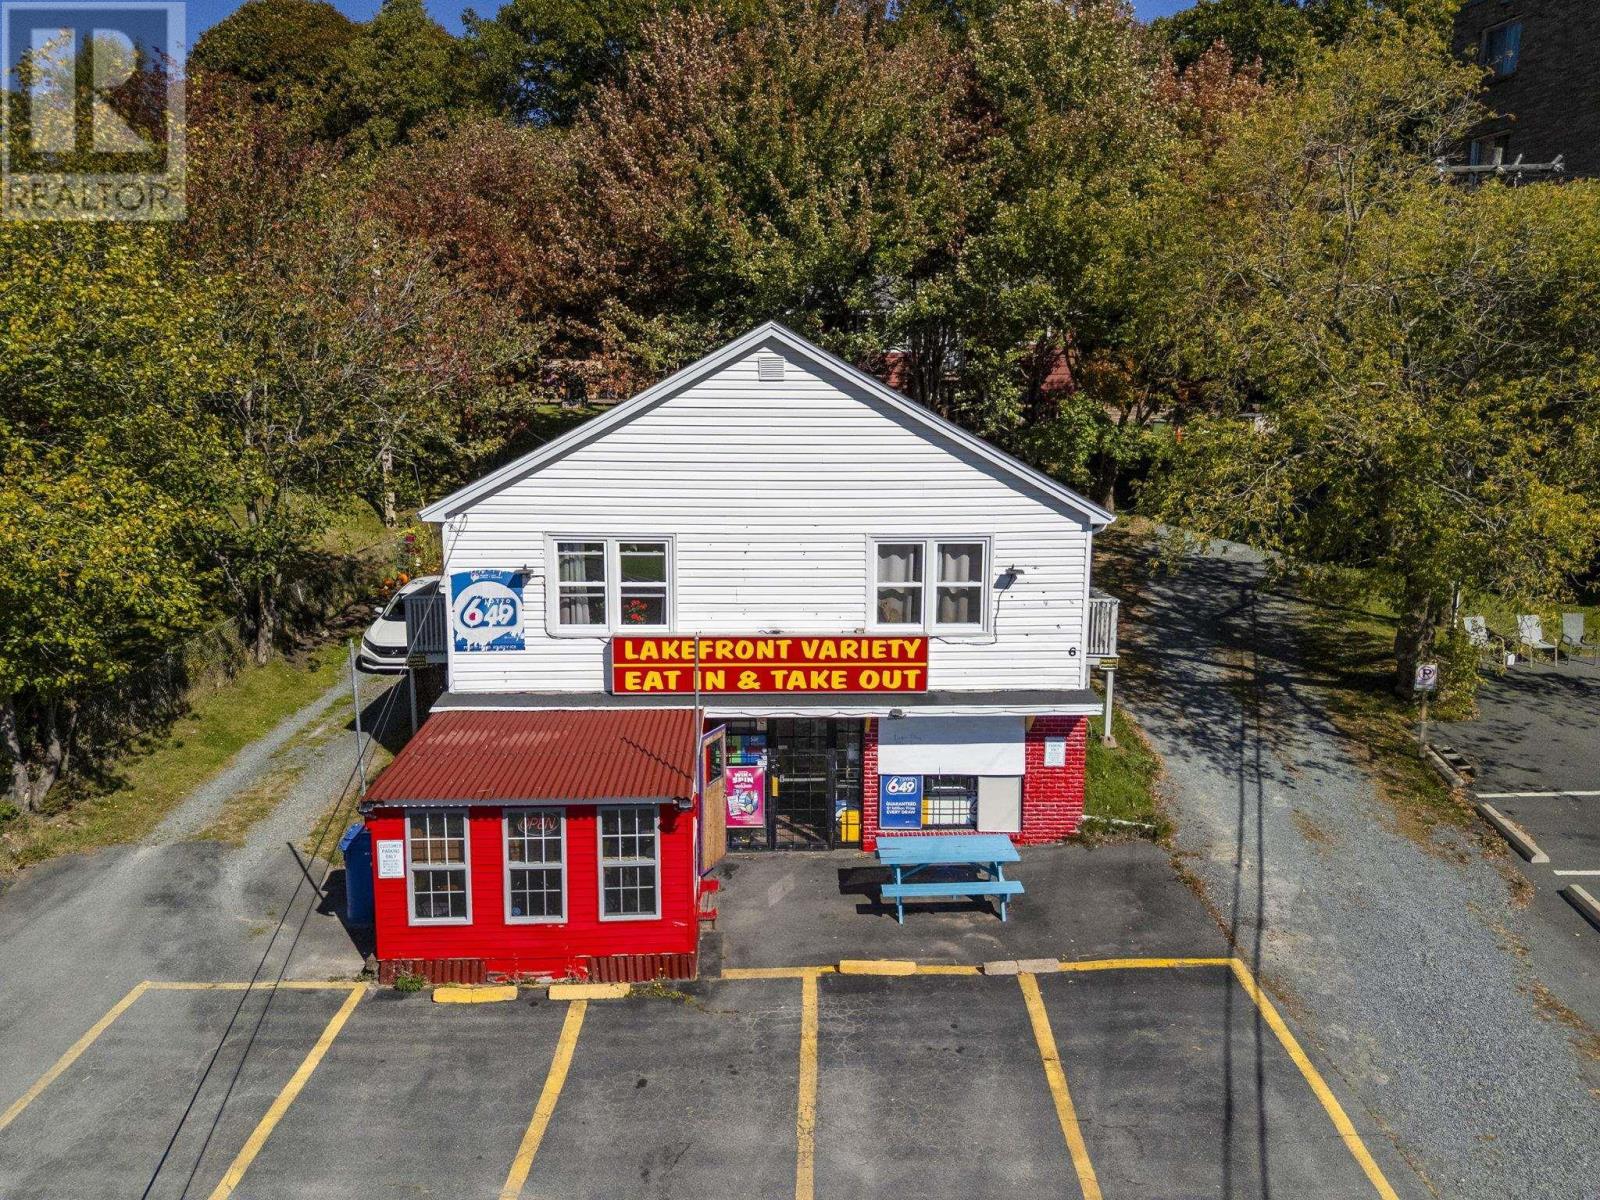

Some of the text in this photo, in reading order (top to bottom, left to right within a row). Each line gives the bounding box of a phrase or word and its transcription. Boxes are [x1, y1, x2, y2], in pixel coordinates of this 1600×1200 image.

[625, 639, 922, 660] LAKEFRONT VARIETY
[1068, 647, 1076, 657] 6
[625, 668, 922, 691] EAT IN & TAKE OUT
[888, 777, 915, 794] 649
